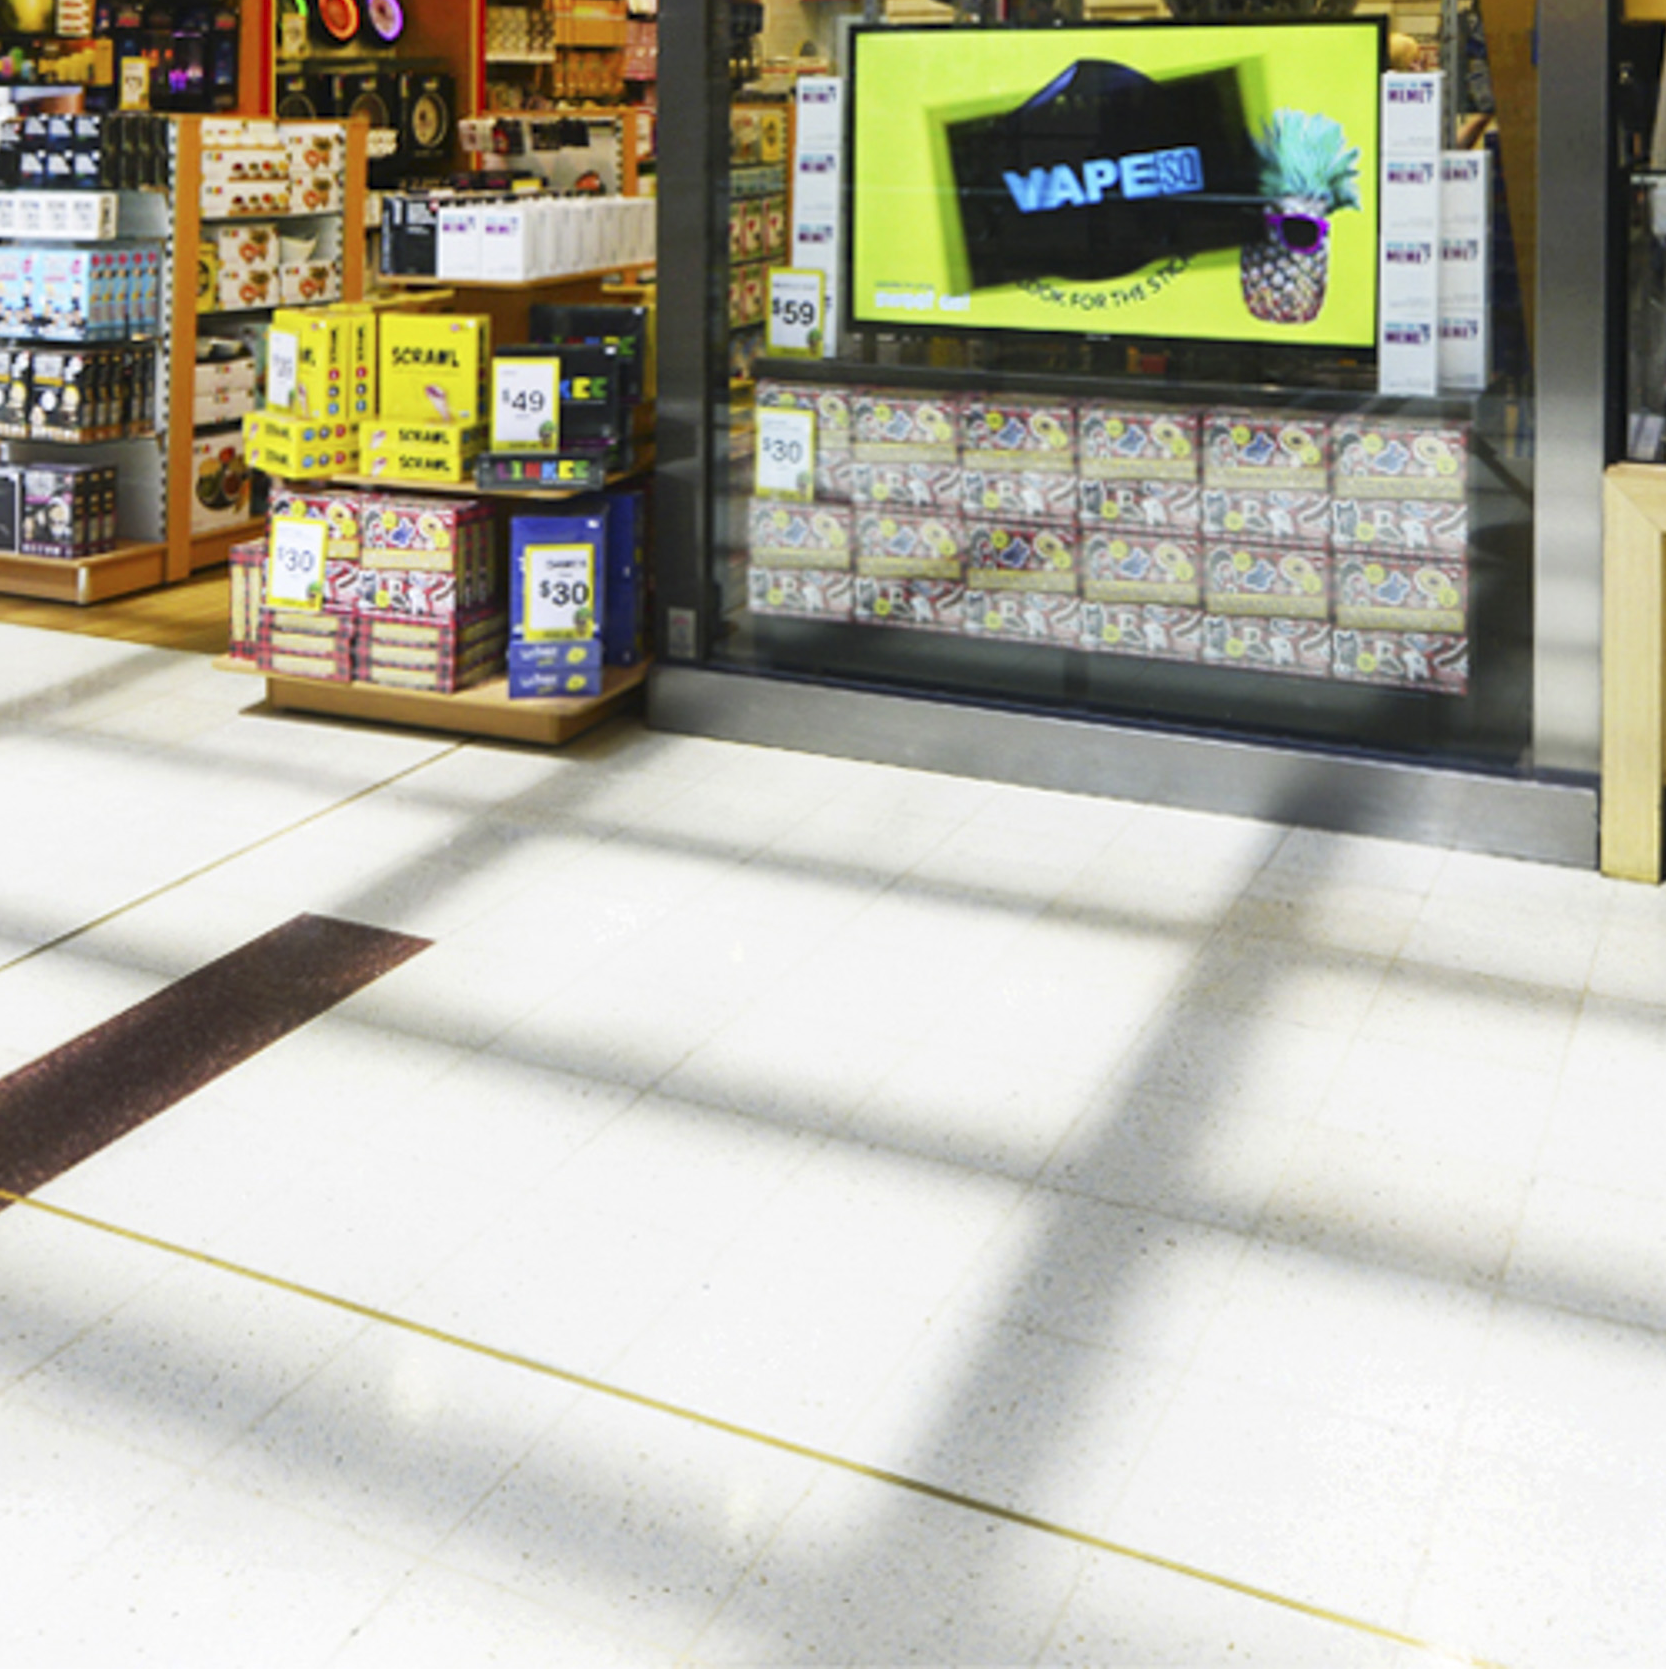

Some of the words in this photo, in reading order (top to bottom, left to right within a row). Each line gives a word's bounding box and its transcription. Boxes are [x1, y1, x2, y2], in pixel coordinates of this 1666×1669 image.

[772, 297, 816, 327] $59
[392, 346, 460, 369] SCRAWL
[502, 387, 546, 413] $49
[560, 376, 608, 400] KEE
[762, 436, 804, 465] $30
[496, 459, 590, 481] LINKEE
[277, 544, 316, 573] $30
[539, 580, 591, 607] $30
